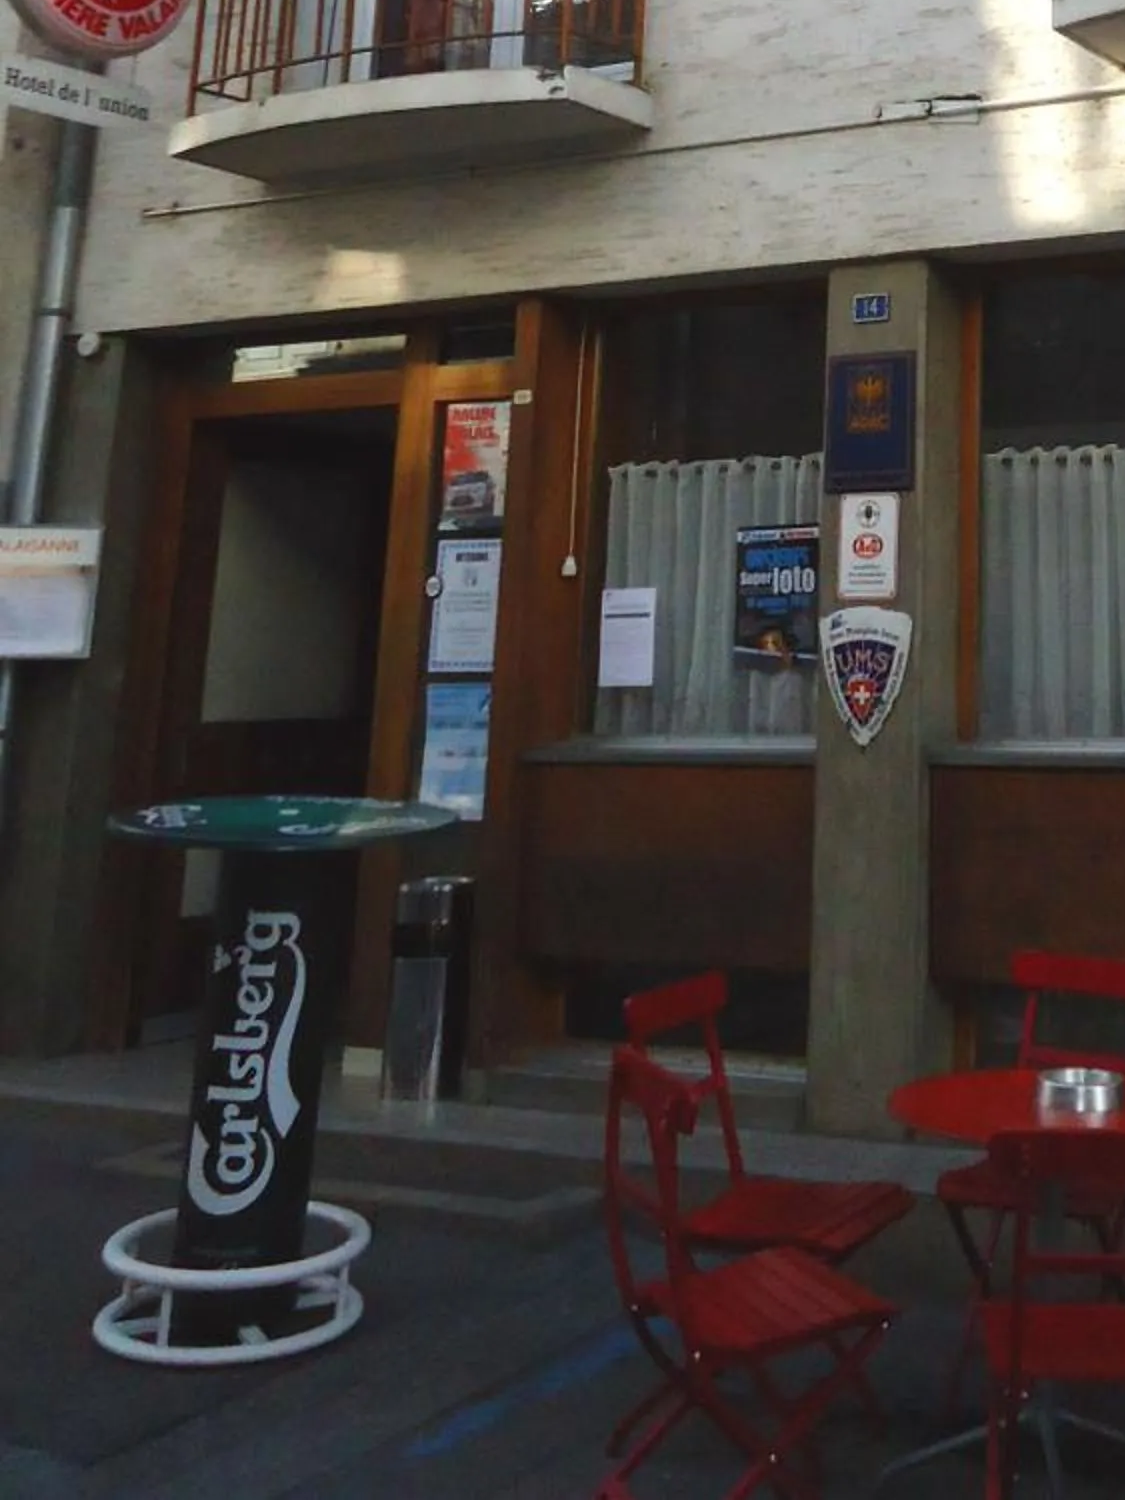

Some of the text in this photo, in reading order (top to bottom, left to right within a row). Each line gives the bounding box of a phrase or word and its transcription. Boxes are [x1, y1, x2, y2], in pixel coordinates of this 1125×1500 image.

[4, 66, 55, 98] Hotel
[57, 83, 80, 104] de
[98, 96, 151, 122] union
[863, 297, 880, 317] 14
[772, 565, 815, 595] loto
[836, 647, 893, 674] UMS
[188, 908, 309, 1216] Carlsberg
